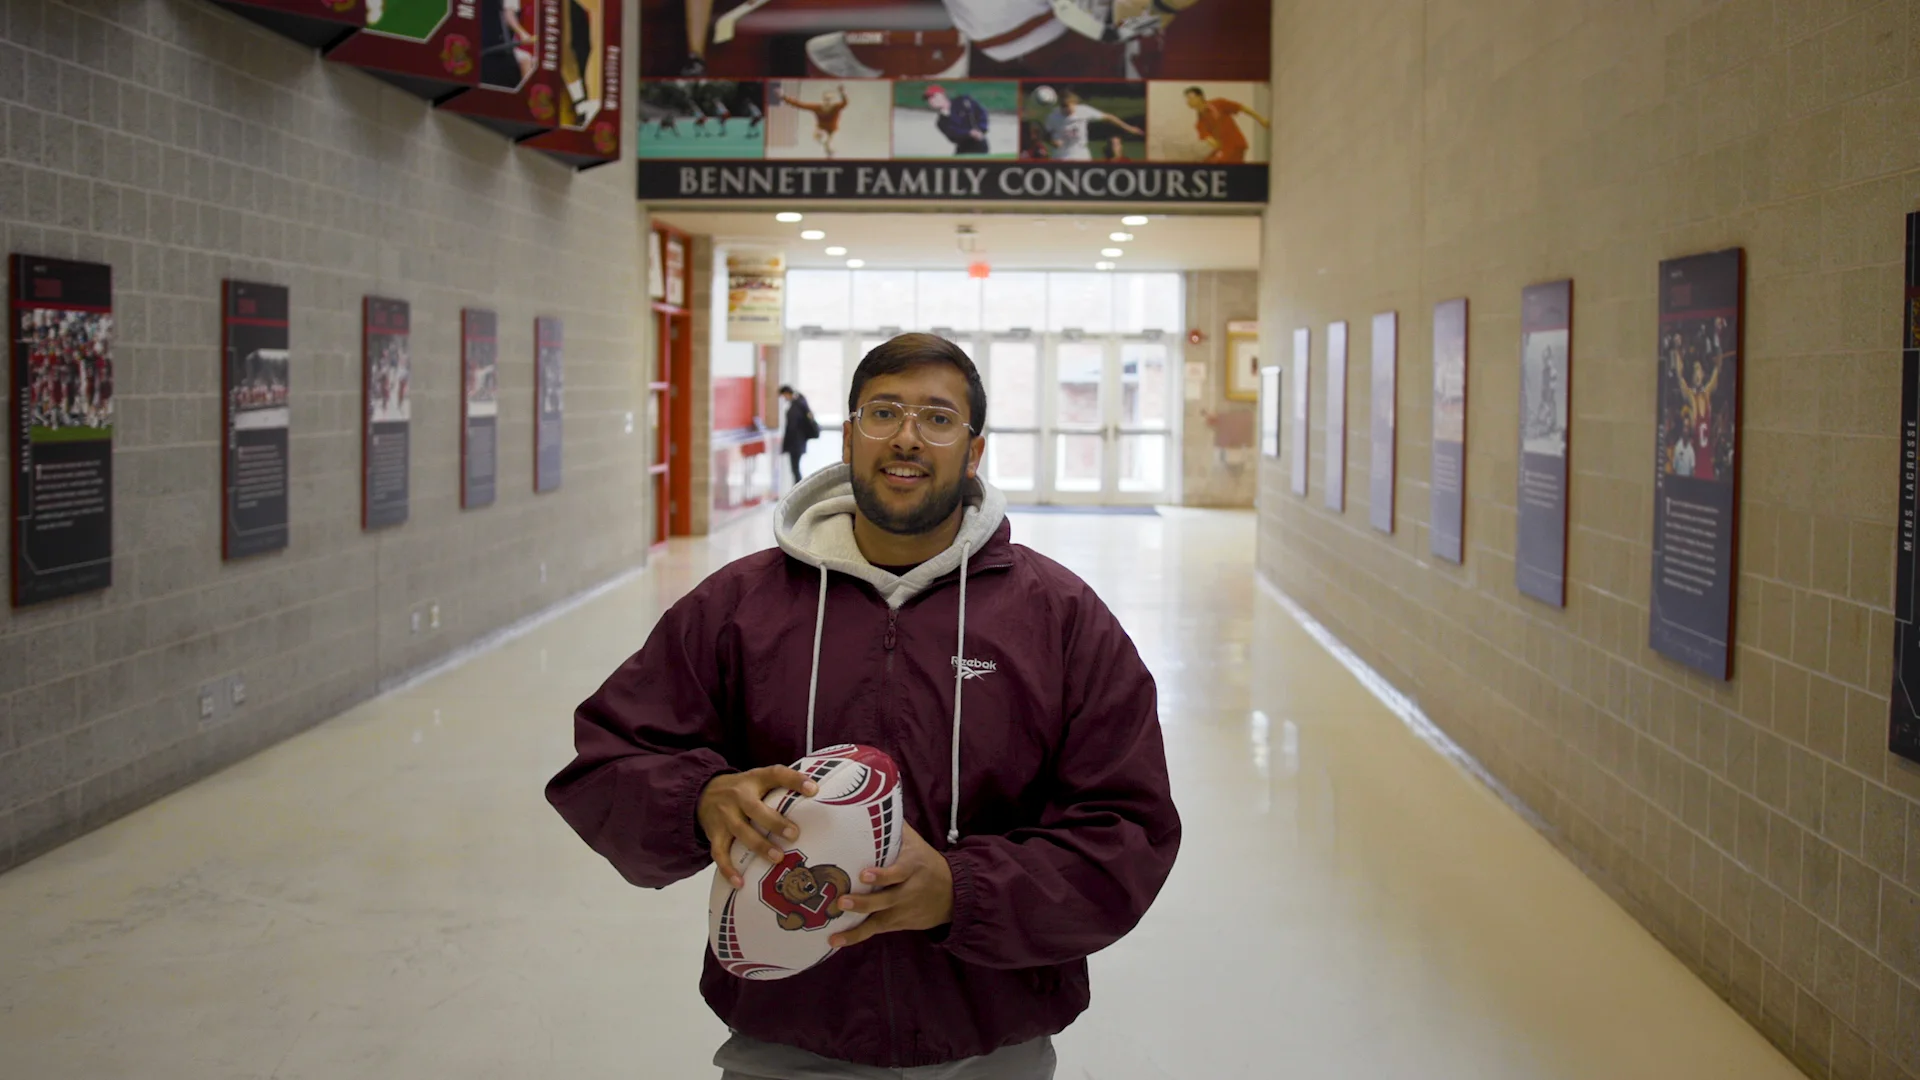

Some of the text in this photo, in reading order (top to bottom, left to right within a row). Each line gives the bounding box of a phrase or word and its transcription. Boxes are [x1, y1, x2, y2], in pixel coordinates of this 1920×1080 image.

[679, 165, 1227, 197] BENNETT FAMILY CONCOURSE
[1903, 420, 1917, 552] MENS LACROSSE
